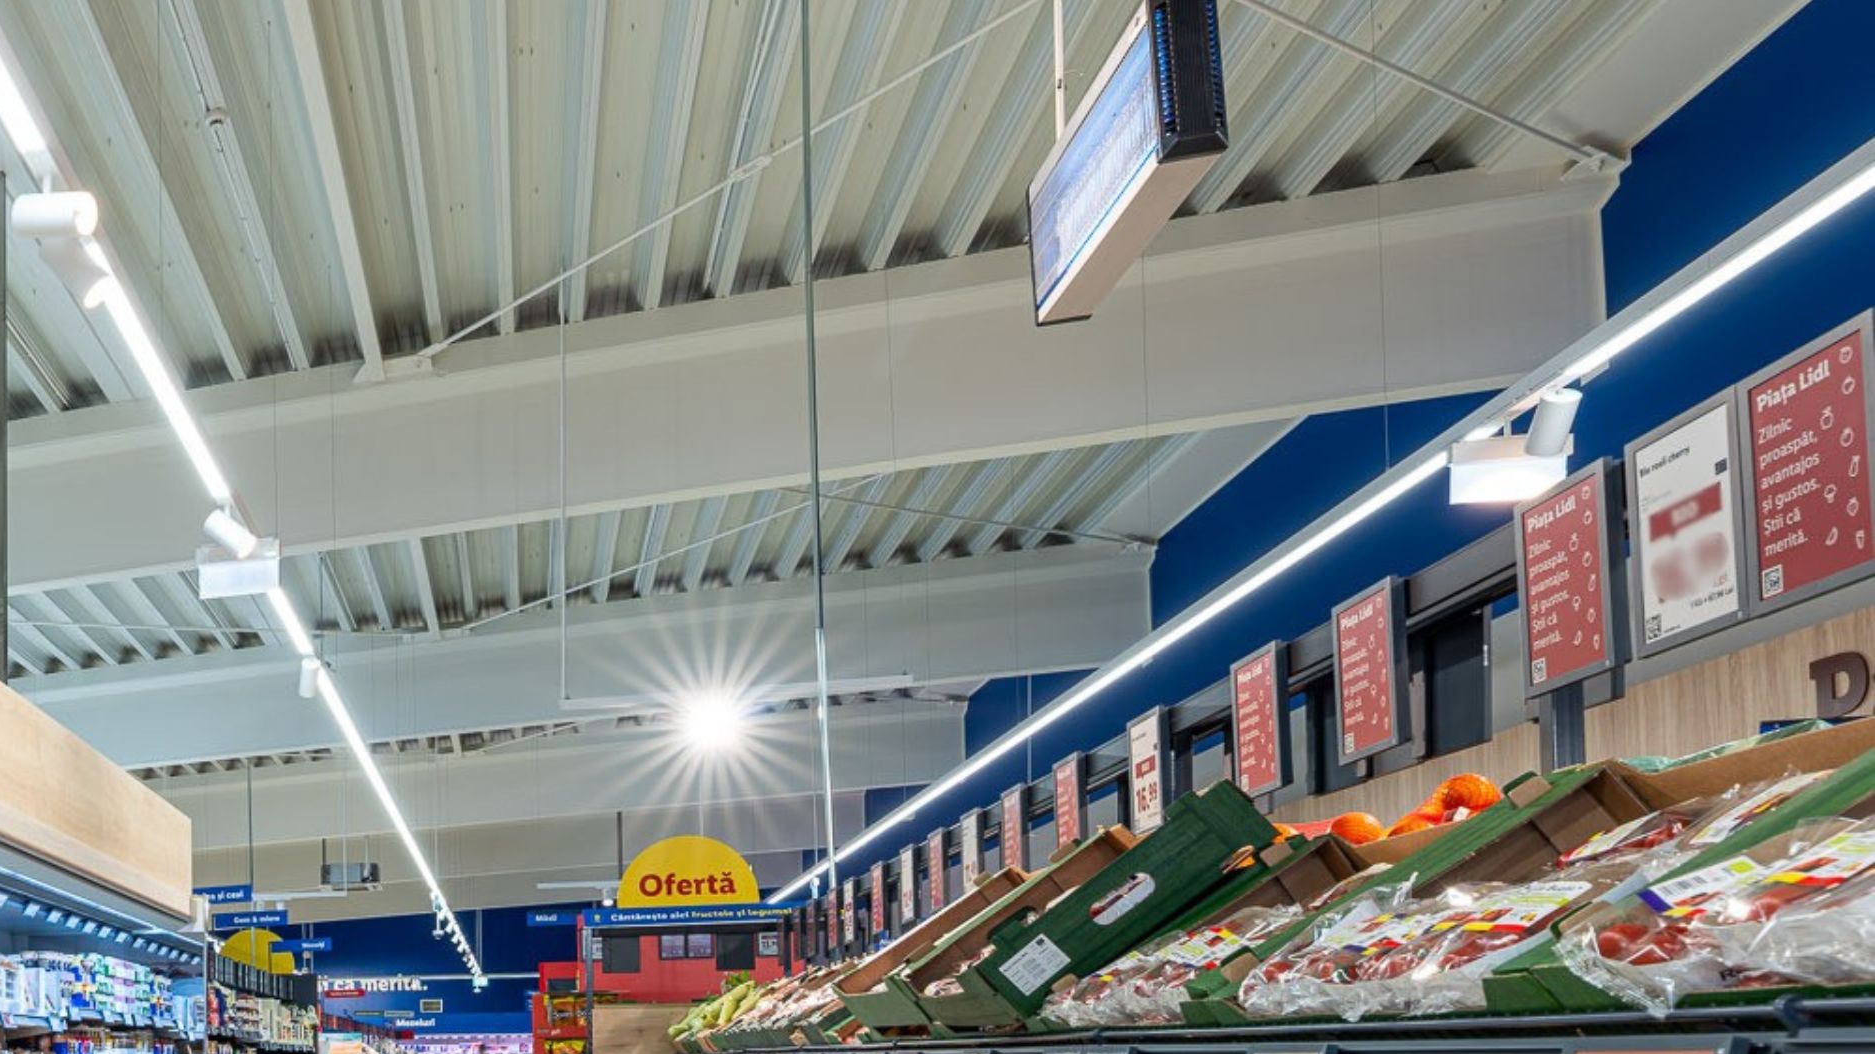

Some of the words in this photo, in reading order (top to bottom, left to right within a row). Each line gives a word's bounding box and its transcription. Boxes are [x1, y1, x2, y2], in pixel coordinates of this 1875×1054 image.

[1756, 382, 1796, 412] Piața
[1799, 360, 1831, 390] Lidl
[1757, 416, 1792, 444] Zilnic
[1759, 432, 1817, 470] proaspăt,
[1761, 453, 1820, 489] avantajos
[1775, 477, 1821, 510] gustos.
[1527, 511, 1554, 534] Piața
[1555, 495, 1576, 517] Lidl
[1763, 516, 1783, 536] Știi
[1786, 509, 1801, 524] că
[1765, 530, 1808, 556] merită.
[1808, 652, 1870, 719] D
[638, 872, 737, 897] Ofertă
